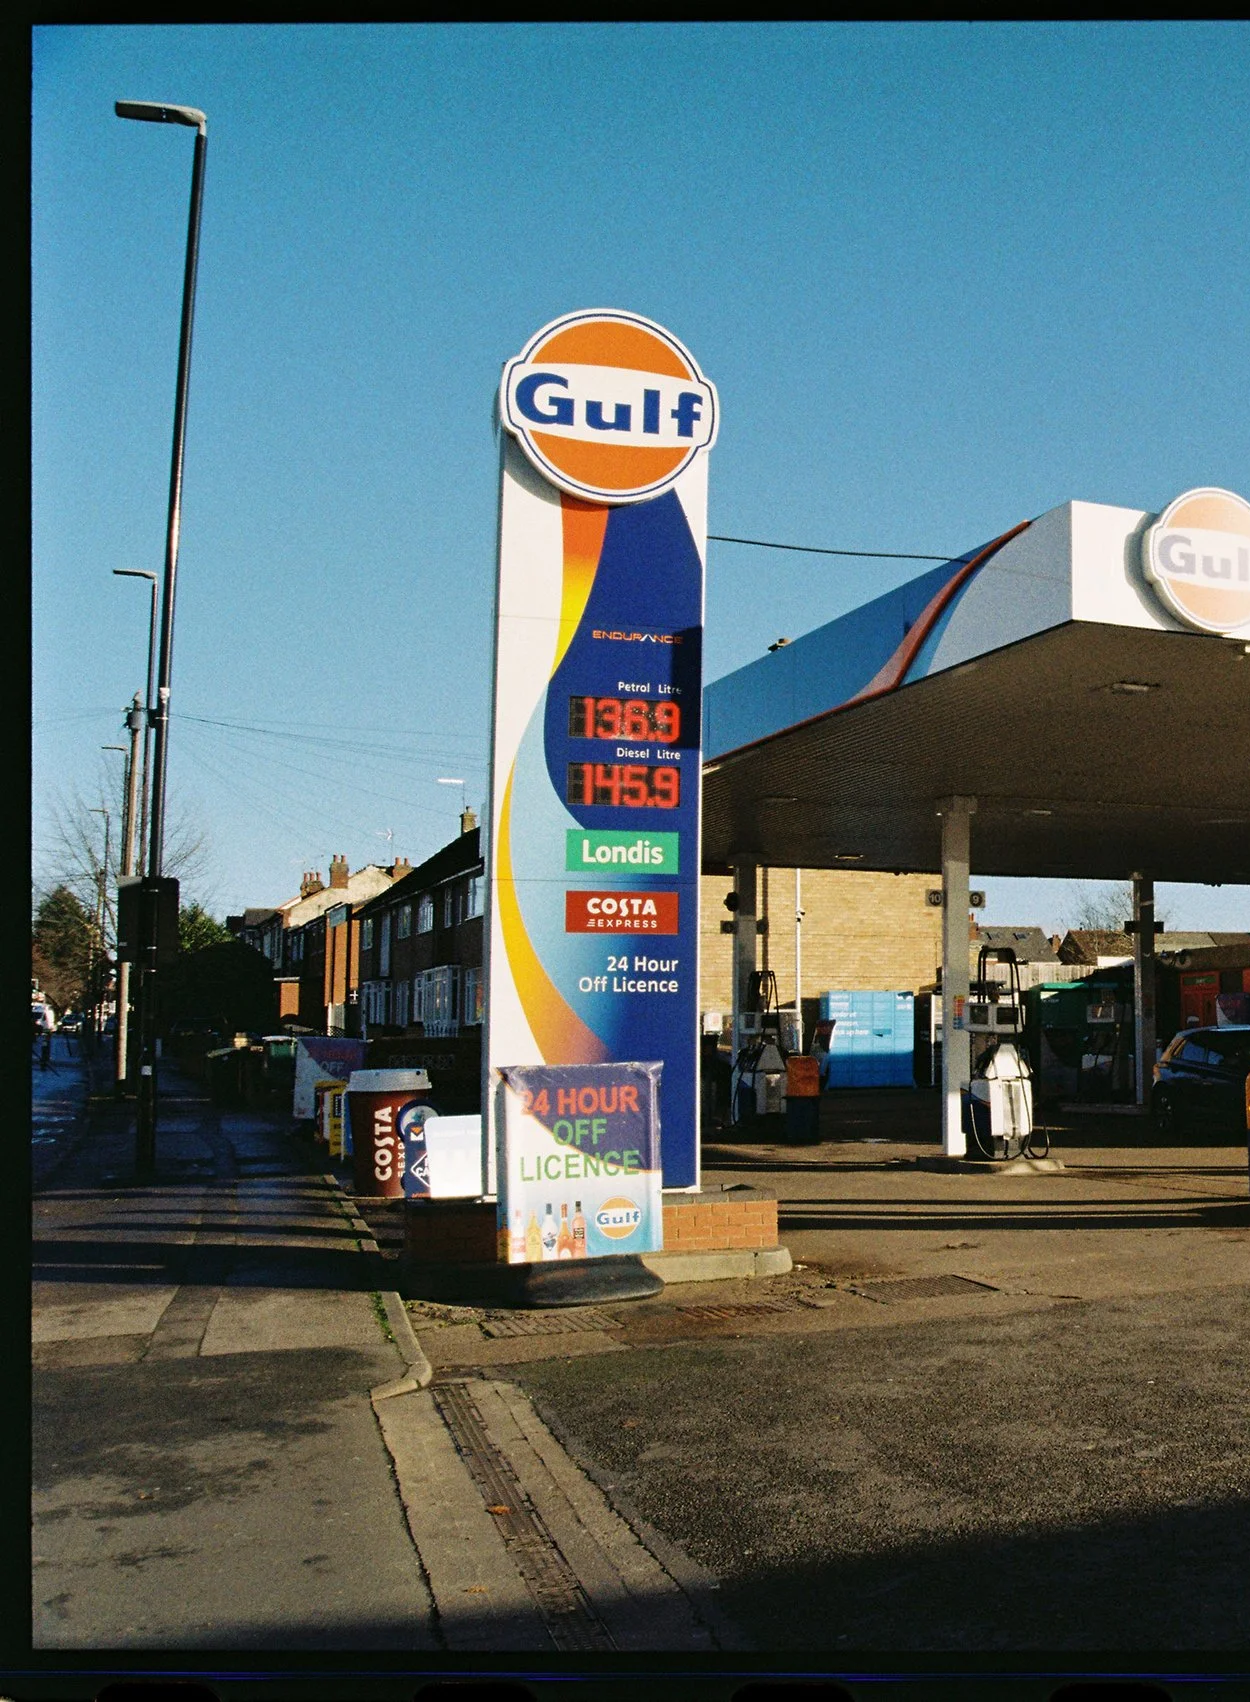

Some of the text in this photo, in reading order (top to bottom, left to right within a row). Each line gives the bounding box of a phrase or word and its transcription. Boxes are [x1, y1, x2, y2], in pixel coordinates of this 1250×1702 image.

[515, 371, 703, 438] Gulf
[591, 630, 684, 644] ENDURANCE
[617, 681, 682, 695] Petrol Litre
[583, 696, 681, 744] 136.9
[616, 747, 681, 760] Diesel Litre
[582, 763, 680, 808] 145.9
[582, 838, 664, 865] Londis
[587, 897, 658, 917] COSTA
[929, 893, 941, 903] 10
[972, 895, 980, 904] 9
[597, 918, 658, 928] EXPRESS
[607, 955, 679, 972] 24 Hour
[578, 975, 679, 993] Off Licence
[520, 1084, 640, 1116] 24 HOUR
[553, 1117, 607, 1146] OFF
[374, 1106, 395, 1181] COSTA
[520, 1149, 640, 1182] LICENCE
[596, 1211, 640, 1225] Gulf
